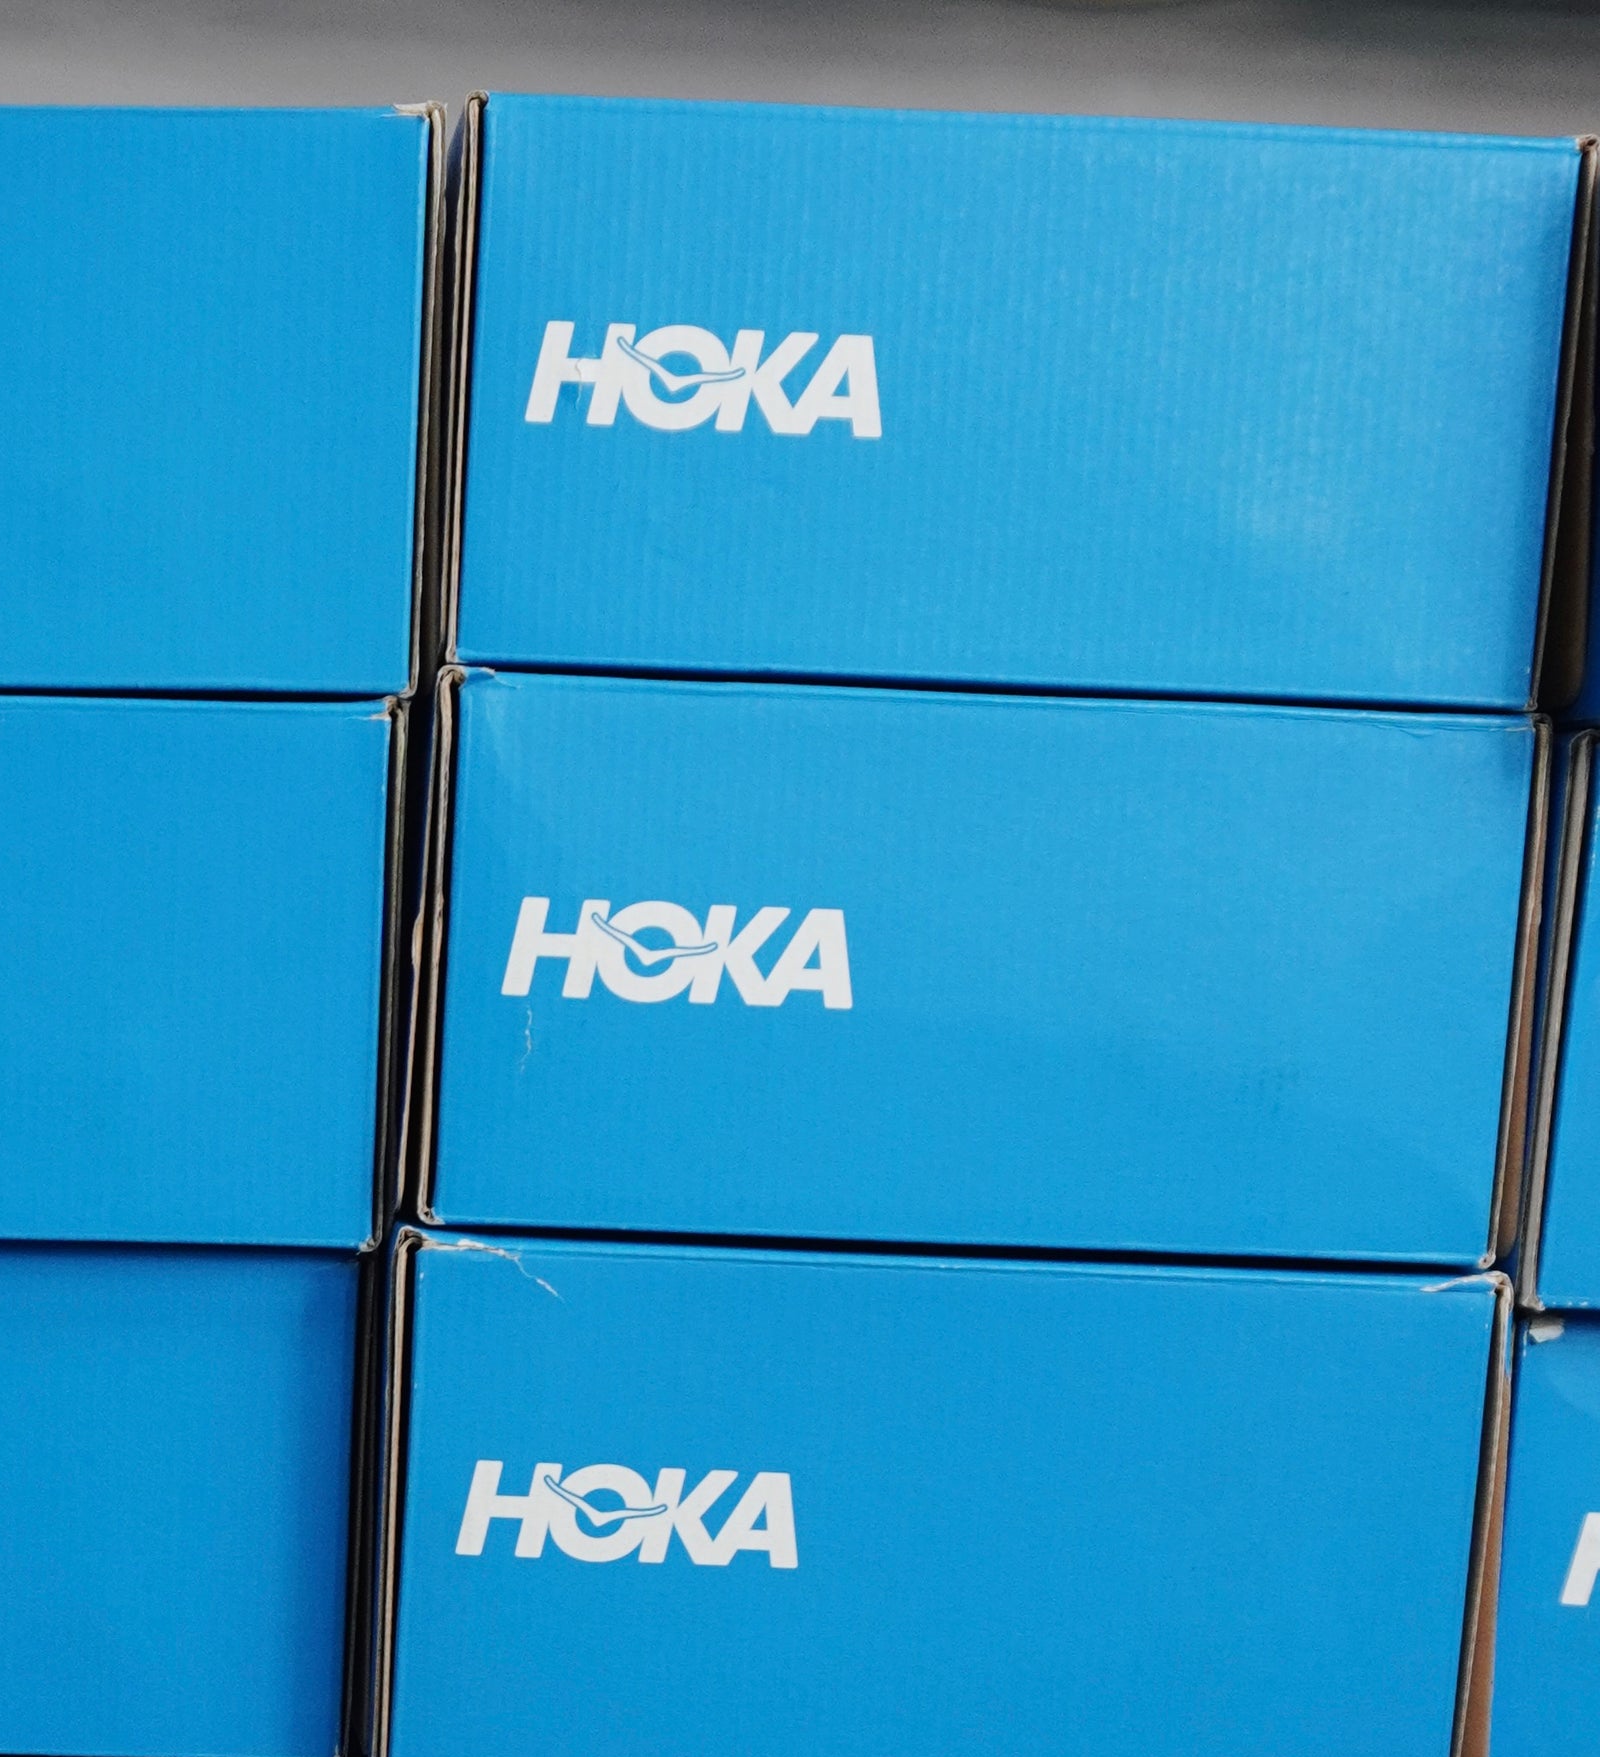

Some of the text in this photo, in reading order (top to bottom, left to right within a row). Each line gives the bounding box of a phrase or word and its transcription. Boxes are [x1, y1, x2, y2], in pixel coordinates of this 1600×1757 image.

[524, 320, 883, 439] HOKA
[501, 896, 853, 1010] HOKA
[455, 1460, 798, 1569] HOKA
